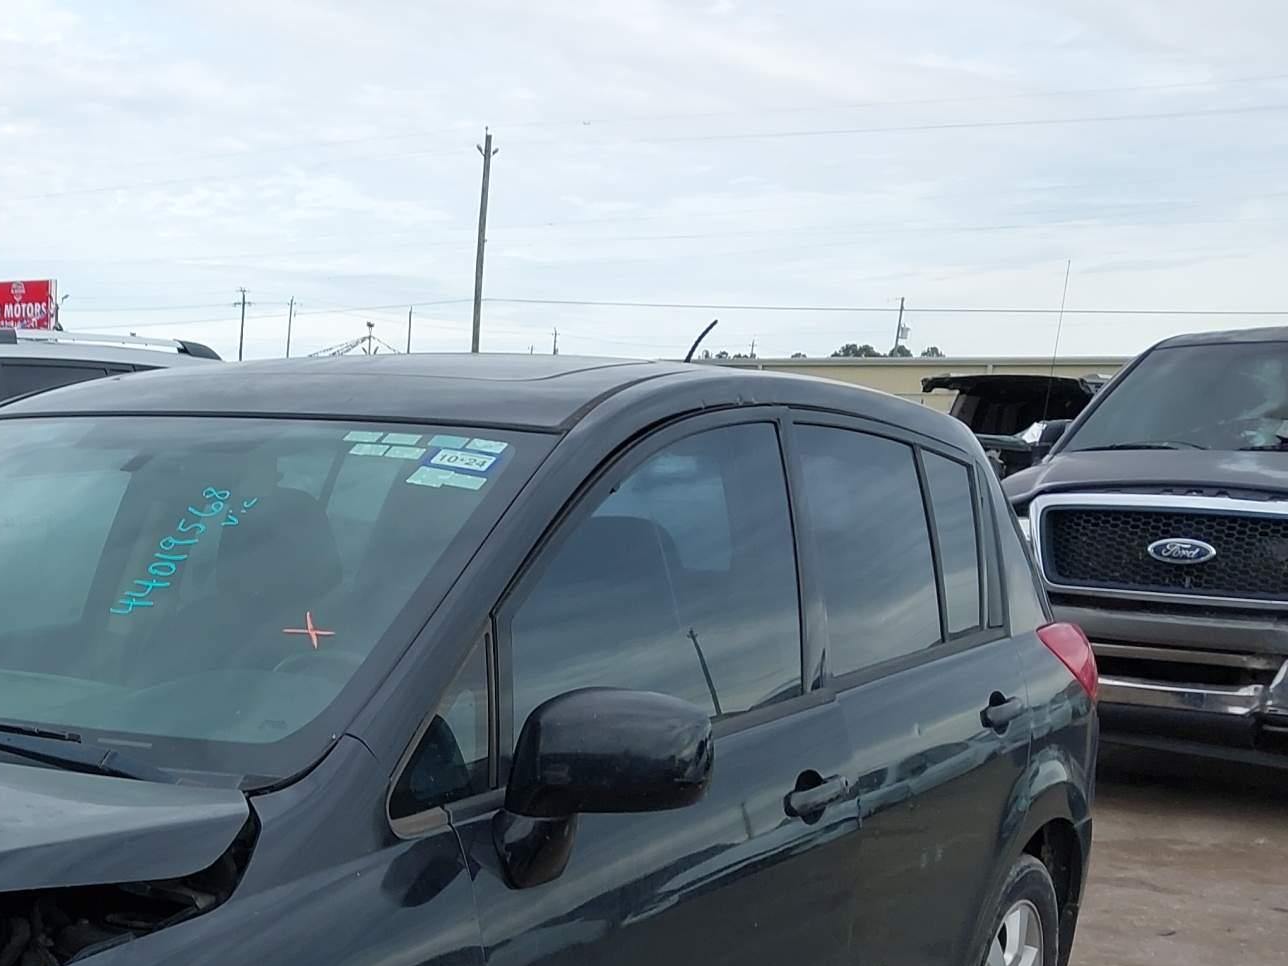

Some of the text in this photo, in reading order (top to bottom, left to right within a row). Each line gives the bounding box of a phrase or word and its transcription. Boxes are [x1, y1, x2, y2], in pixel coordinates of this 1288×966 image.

[4, 302, 47, 319] MOTORS
[110, 487, 231, 616] 44019568
[1161, 543, 1199, 560] Ford
